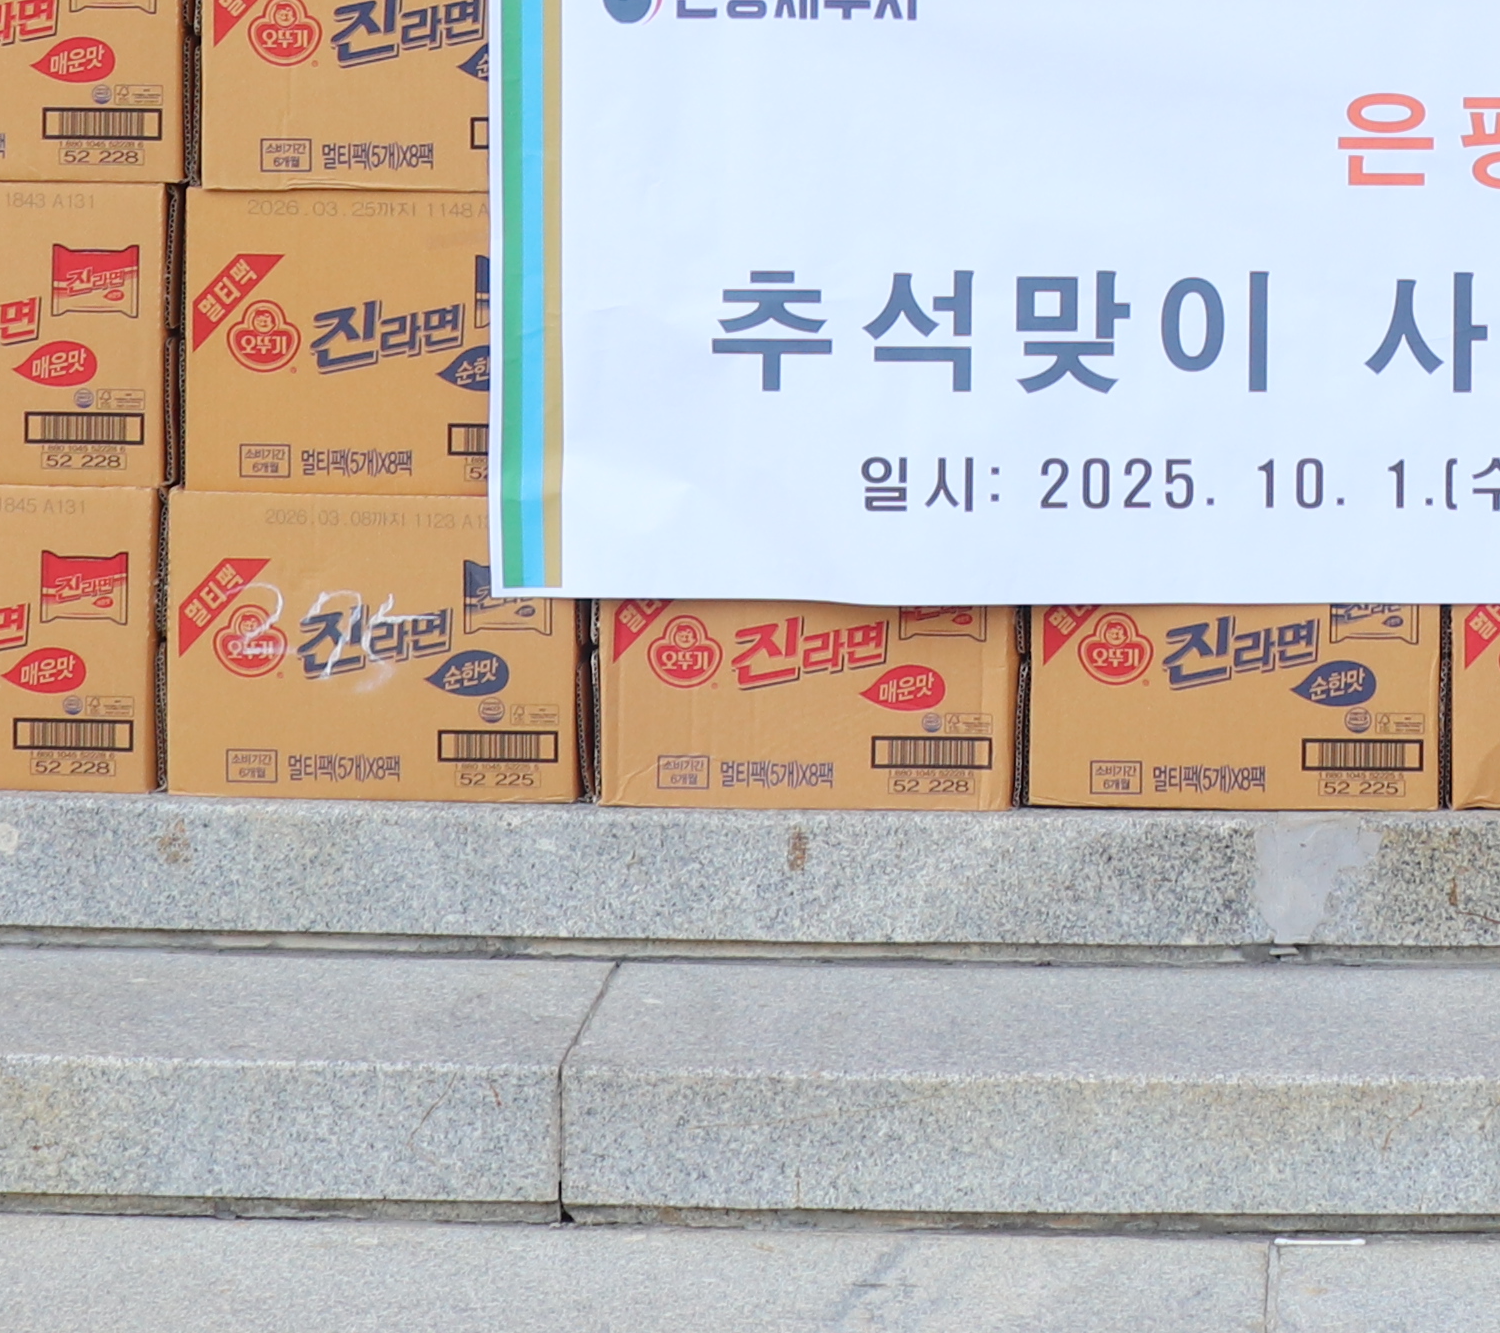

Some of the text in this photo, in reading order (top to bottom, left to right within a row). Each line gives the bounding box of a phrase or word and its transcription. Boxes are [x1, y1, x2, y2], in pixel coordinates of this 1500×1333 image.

[309, 299, 465, 376] 진라면
[710, 269, 1270, 395] 추석맞이
[859, 455, 1002, 512] 일시:
[1038, 457, 1217, 511] 2025.
[730, 617, 890, 692] 진라면
[1161, 613, 1321, 691] 진라면
